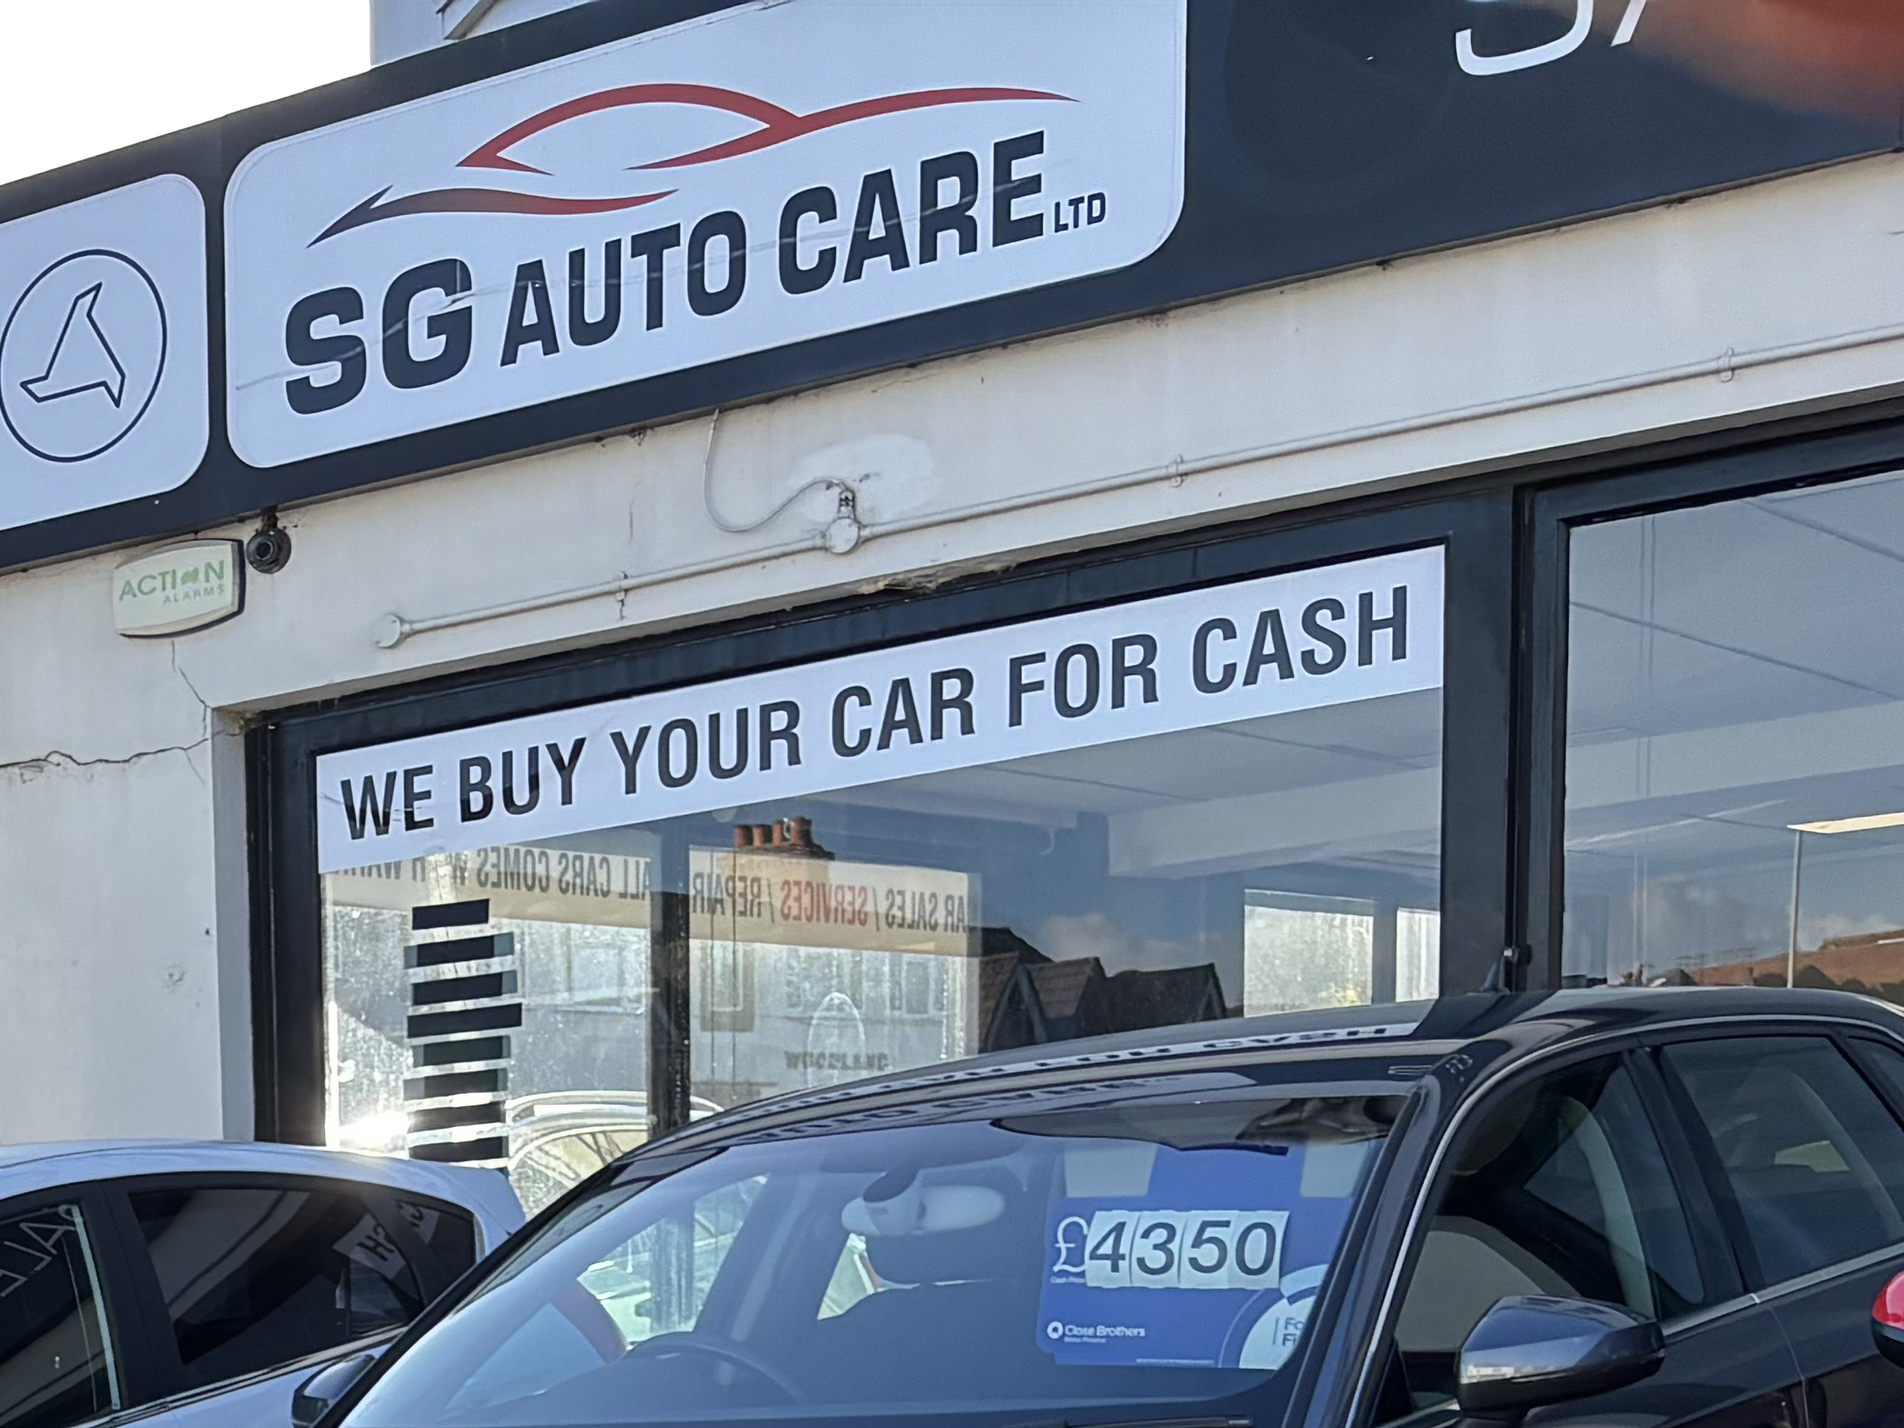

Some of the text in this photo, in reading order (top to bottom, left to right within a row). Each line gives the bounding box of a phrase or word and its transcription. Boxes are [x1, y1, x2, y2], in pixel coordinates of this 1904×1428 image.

[286, 130, 1108, 415] SG AUTO CARE LTD
[163, 584, 224, 604] ALARMS
[340, 584, 1408, 840] WE BUY YOUR CAR FOR CASH
[1053, 1216, 1277, 1277] £4350
[1096, 1325, 1146, 1337] Brothers
